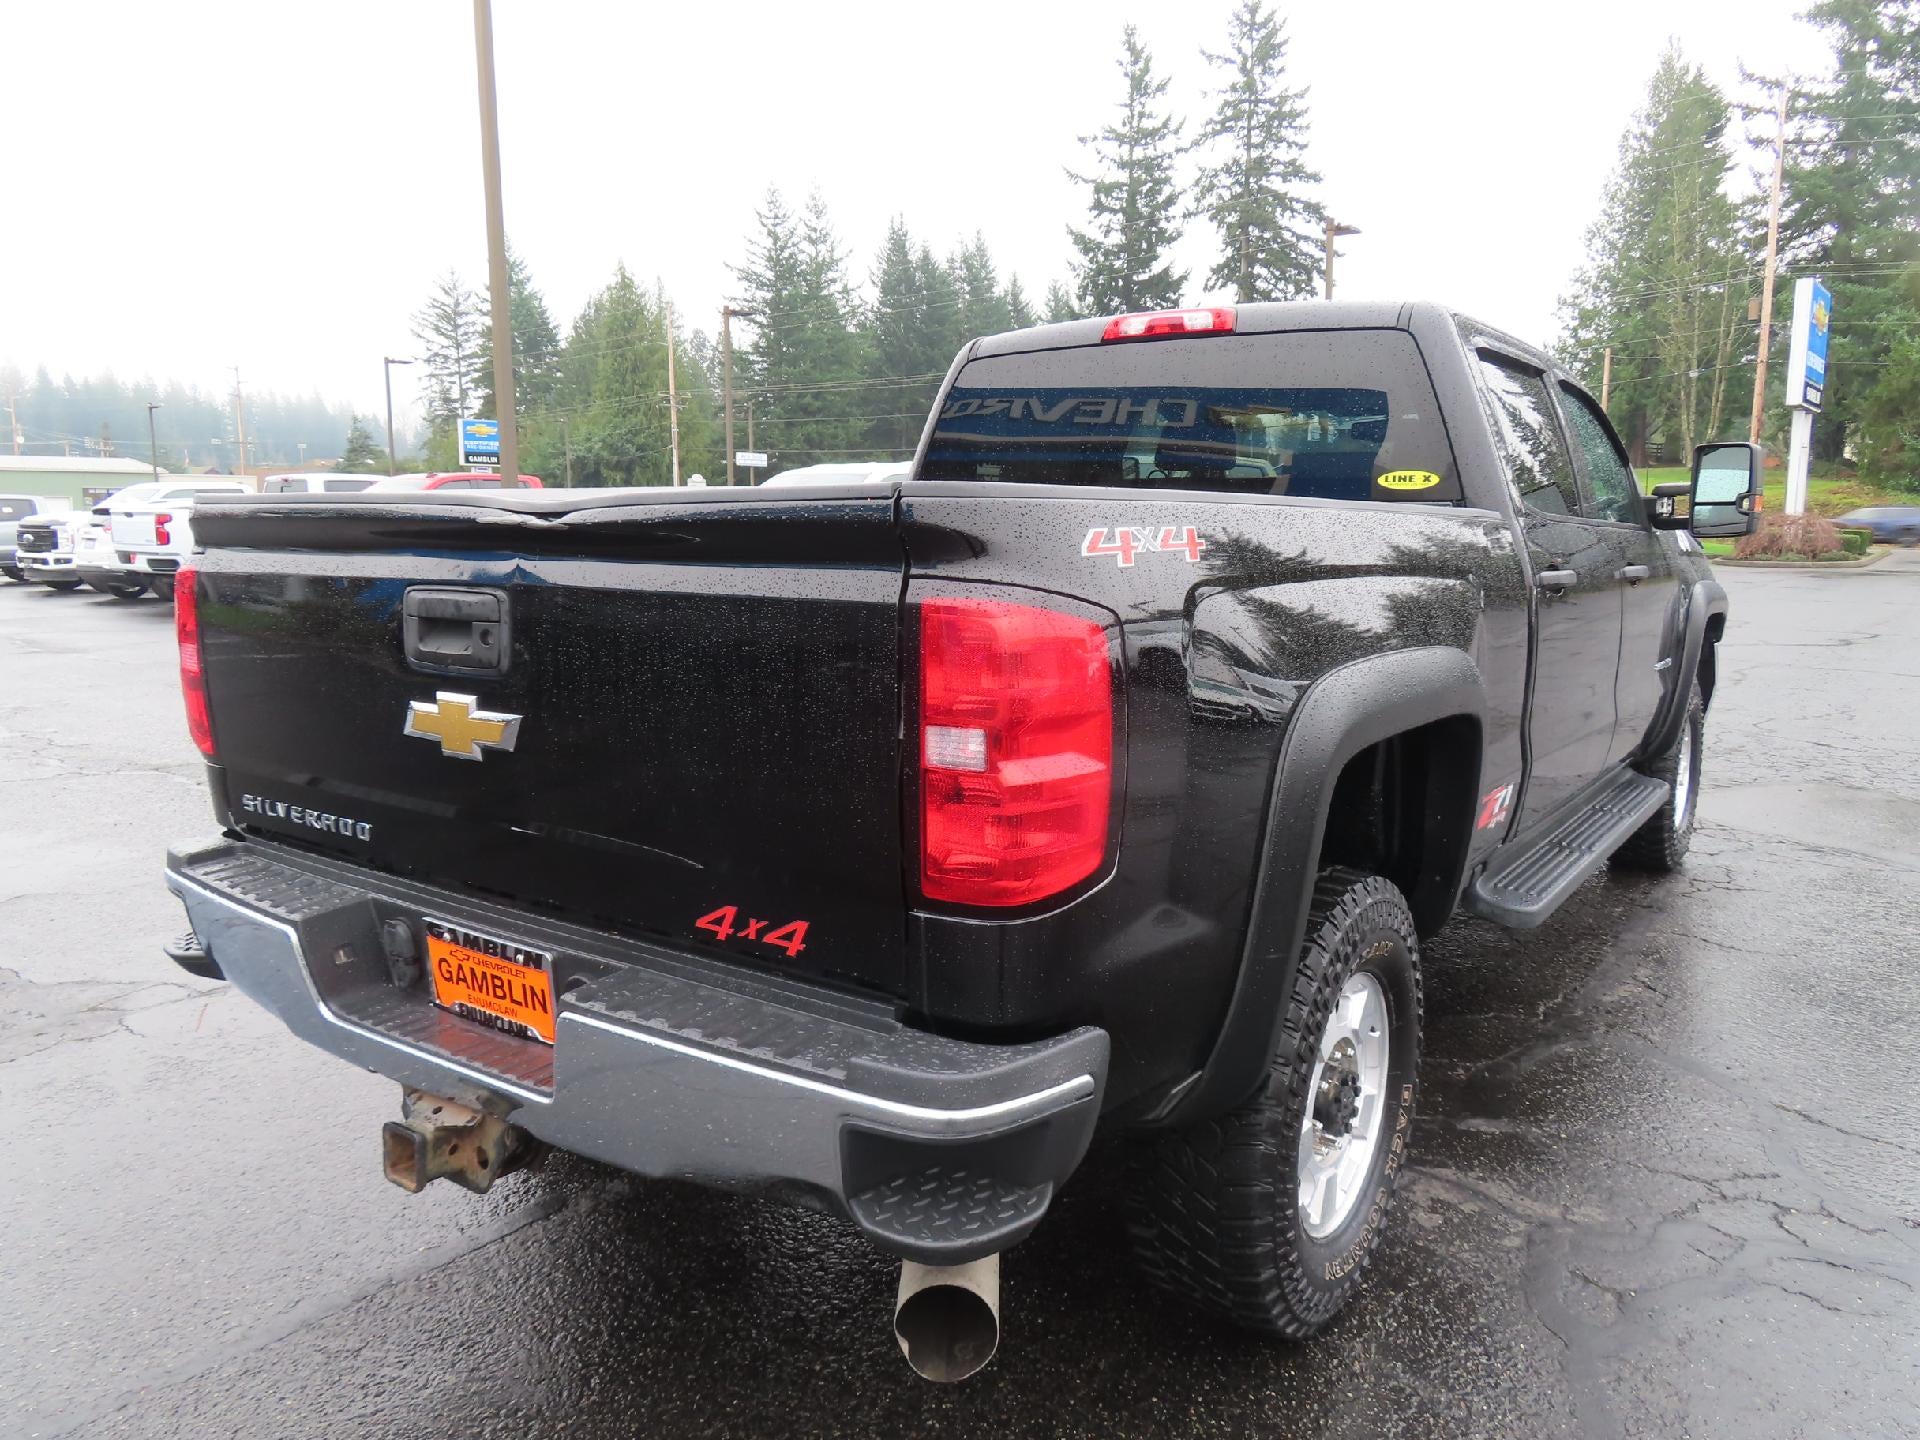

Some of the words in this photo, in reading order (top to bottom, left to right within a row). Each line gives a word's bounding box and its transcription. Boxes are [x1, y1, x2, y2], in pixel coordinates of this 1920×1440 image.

[468, 455, 498, 463] GAMBLIN
[1384, 474, 1417, 483] LINE
[1422, 474, 1432, 483] X
[241, 793, 373, 842] SILVERADO
[426, 922, 543, 971] GAMBLIN
[472, 956, 528, 980] CHEVROLET
[437, 957, 549, 1014] GAMBLIN
[467, 993, 519, 1018] ENUMCLAW
